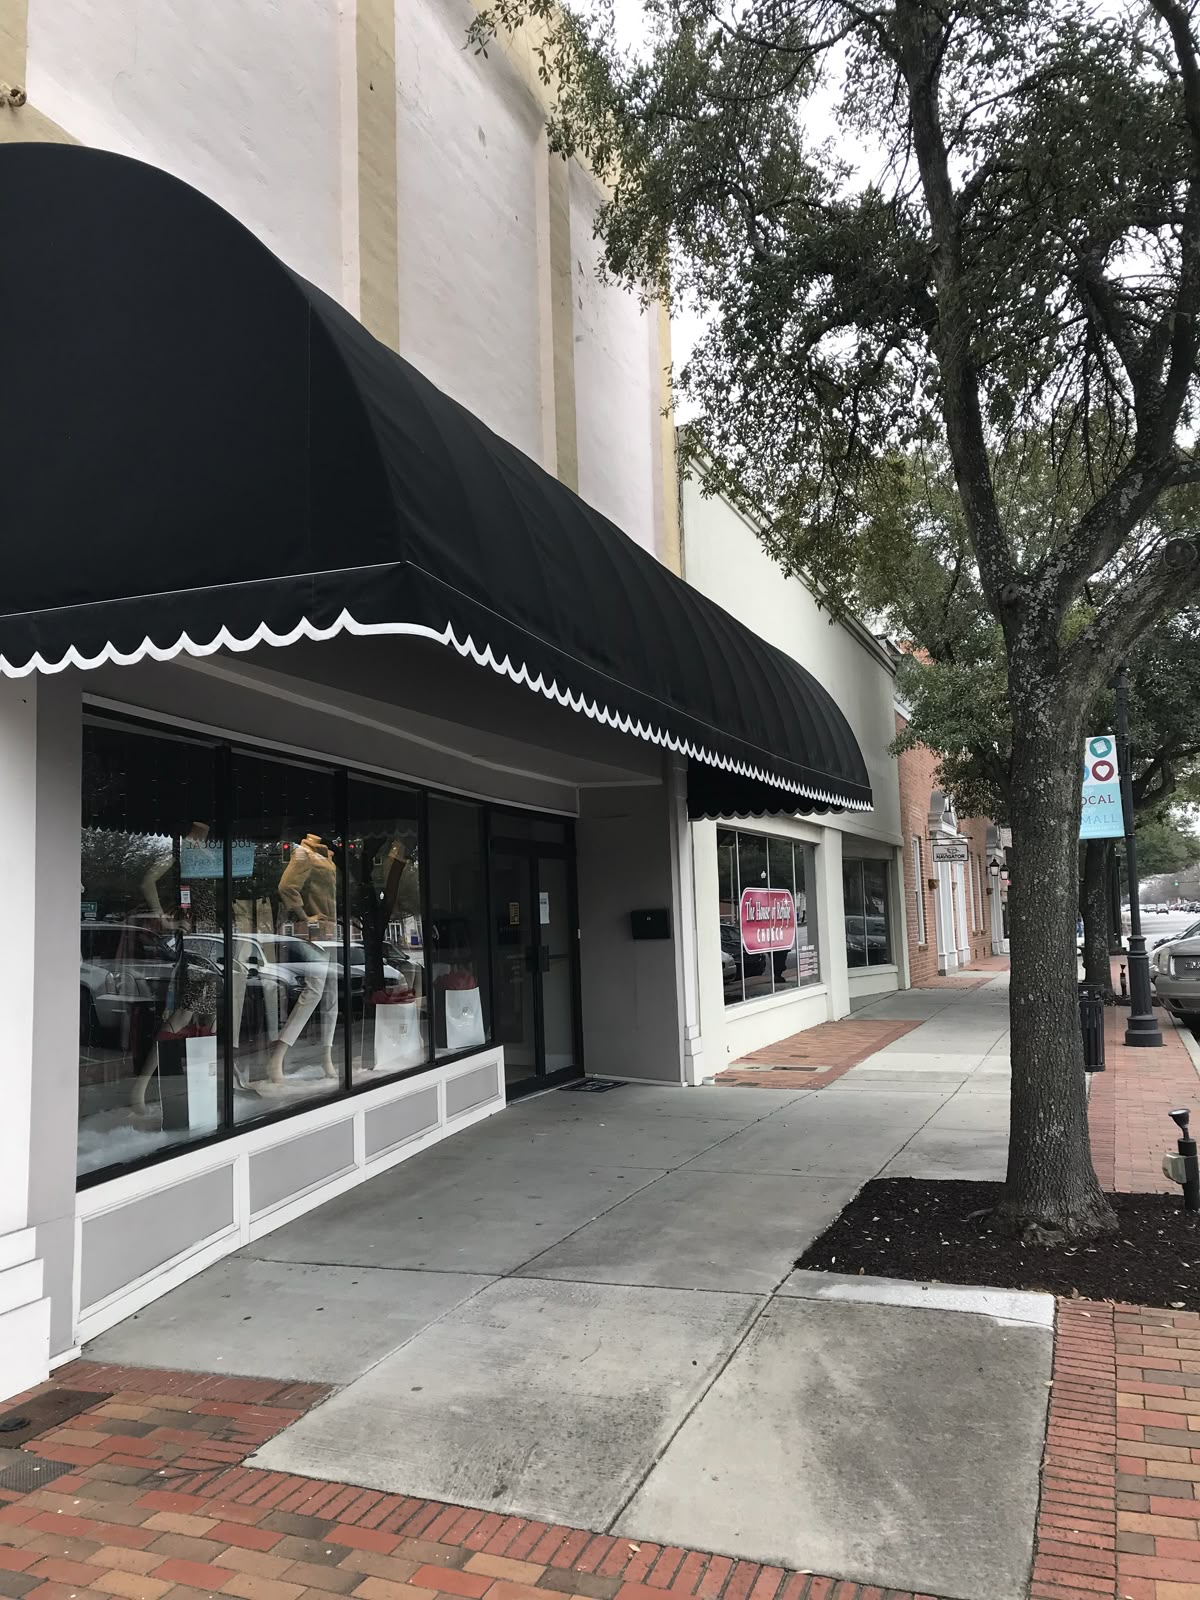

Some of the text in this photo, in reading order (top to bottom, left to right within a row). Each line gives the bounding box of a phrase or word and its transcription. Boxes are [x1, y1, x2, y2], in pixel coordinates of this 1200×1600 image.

[1081, 794, 1115, 806] OCAL
[1082, 814, 1118, 825] MALL
[745, 898, 755, 921] The
[757, 927, 784, 943] CHURCH
